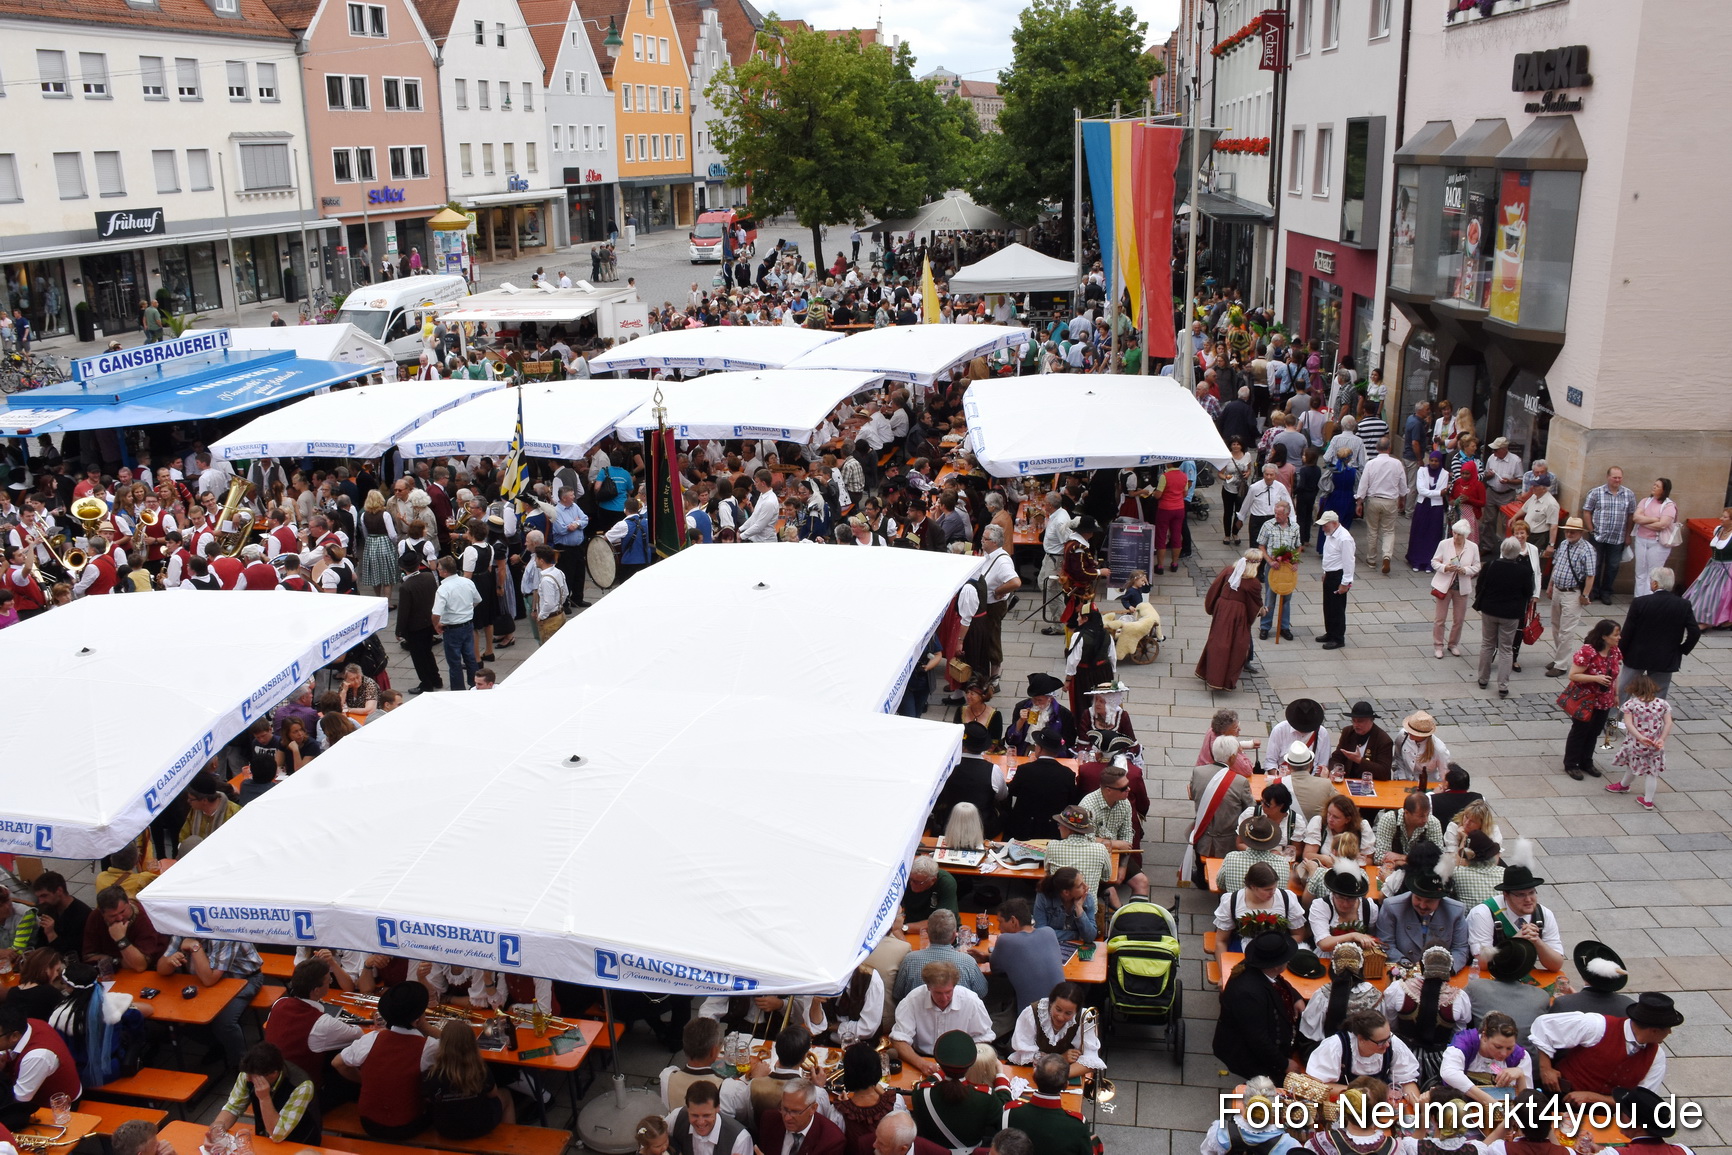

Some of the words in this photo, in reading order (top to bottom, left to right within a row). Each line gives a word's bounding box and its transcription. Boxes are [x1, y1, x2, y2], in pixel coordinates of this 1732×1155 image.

[1265, 22, 1279, 66] Achatz
[1524, 103, 1540, 113] am
[508, 173, 529, 192] fries
[102, 211, 161, 236] frühauf
[99, 335, 217, 374] GANSBRAUEREI
[157, 739, 203, 791] GANSBRÄU
[209, 906, 290, 921] GANSBRÄU
[400, 920, 496, 944] GANSBRÄU
[400, 940, 443, 952] Neumarkt's
[621, 953, 730, 985] GANSBRÄU
